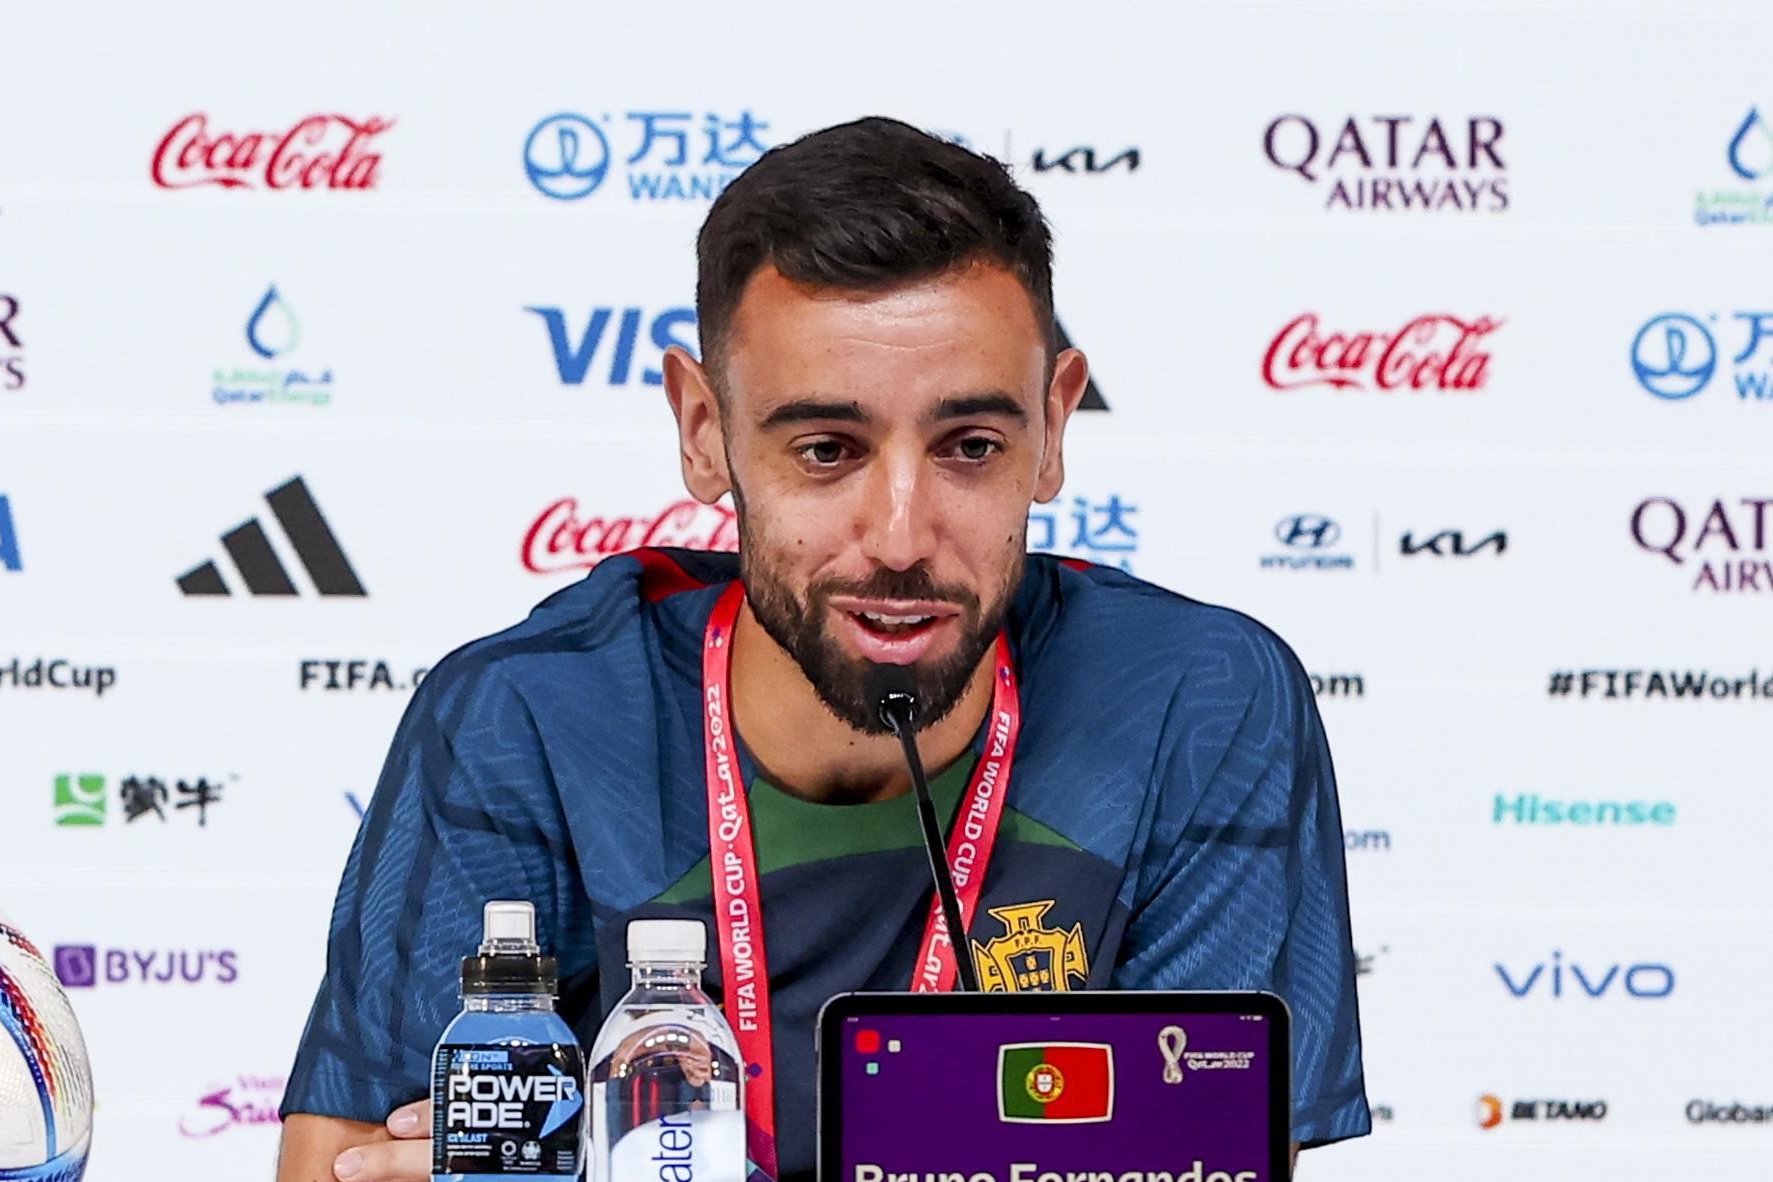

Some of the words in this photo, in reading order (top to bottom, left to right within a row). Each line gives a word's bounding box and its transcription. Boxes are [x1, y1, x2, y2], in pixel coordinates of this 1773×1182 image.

[626, 111, 770, 167] 万达
[1262, 113, 1508, 182] QATAR
[1324, 178, 1510, 211] AIRWAYS
[523, 306, 699, 385] VIS
[990, 711, 1010, 757] FIFA
[965, 762, 1001, 840] WORLD
[1493, 794, 1676, 826] Hisense
[724, 851, 745, 895] CUP
[952, 842, 975, 887] CUP
[730, 898, 754, 981] WORLD
[107, 951, 239, 984] BYJU'S
[1494, 950, 1675, 999] vivo
[738, 982, 758, 1031] FIFA
[448, 1075, 577, 1101] POWER
[1511, 1099, 1608, 1122] BETANO
[447, 1101, 532, 1128] ADE.
